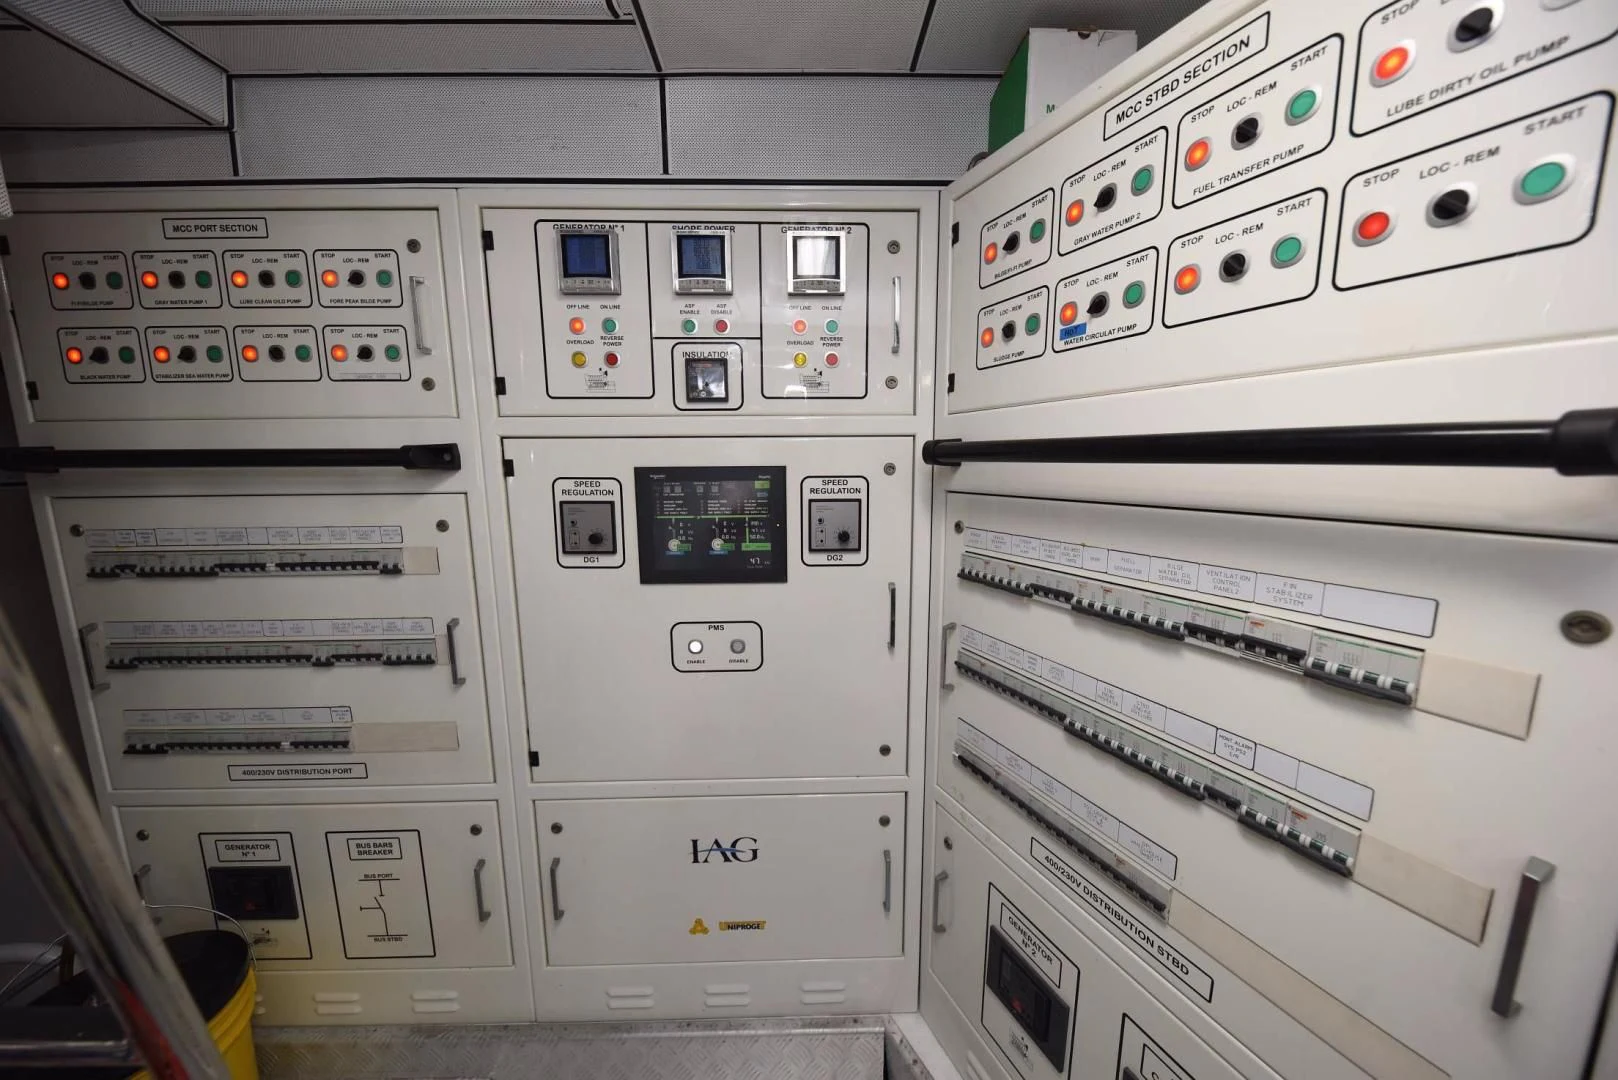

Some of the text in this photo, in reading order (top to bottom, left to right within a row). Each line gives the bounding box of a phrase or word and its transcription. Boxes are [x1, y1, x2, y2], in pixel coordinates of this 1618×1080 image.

[1290, 45, 1328, 71] START
[1115, 35, 1250, 125] MCC STBD SECTION
[1386, 35, 1569, 118] LUBE DIRTY OIL PUMP
[1226, 96, 1247, 113] LOC
[1254, 81, 1277, 99] REM
[1191, 105, 1215, 123] STOP
[1524, 106, 1586, 136] START
[1134, 135, 1159, 153] START
[1193, 144, 1305, 196] FUEL TRANSFER PUMP
[1418, 162, 1451, 180] LOC
[1463, 146, 1501, 166] REM
[1093, 159, 1127, 182] LOC REM
[1069, 174, 1086, 188] STOP
[1363, 168, 1400, 188] STOP
[1031, 194, 1049, 208] START
[1276, 197, 1313, 217] START
[1015, 212, 1027, 221] REM
[172, 224, 258, 233] MCC PORT SECTION
[620, 224, 625, 232] 1
[704, 225, 736, 233] POWER
[781, 226, 833, 234] GENERATOR
[846, 226, 852, 234] 2
[986, 221, 999, 233] STOP
[1073, 212, 1141, 246] GRAY WATER PUMP 2
[1215, 232, 1234, 245] LOC
[1241, 222, 1264, 236] REM
[1180, 234, 1204, 249] STOP
[1018, 259, 1032, 270] PUMP
[1126, 253, 1150, 267] START
[1063, 278, 1080, 289] STOP
[1086, 271, 1119, 287] LOC REM
[1027, 291, 1043, 301] START
[983, 308, 995, 317] STOP
[1063, 323, 1137, 346] WATER CIRCULAT PUMP
[1011, 350, 1025, 358] PUMP
[573, 480, 601, 488] SPEED
[809, 487, 861, 495] REGULATION
[1158, 569, 1175, 577] WATER
[1158, 574, 1192, 586] SEPARATOR
[1206, 569, 1251, 582] VENTILATION
[1211, 578, 1241, 588] CONTROL
[1213, 585, 1234, 594] PANEL
[1283, 582, 1297, 590] FIN
[1265, 586, 1313, 601] STABILIZER
[1272, 595, 1304, 607] SYSTEM
[332, 767, 353, 775] PORT
[690, 836, 760, 864] IAG
[1044, 855, 1189, 976] 400/230V DISTRIBUTION STBD
[1008, 916, 1053, 965] GENERATOR
[1031, 948, 1037, 958] 2
